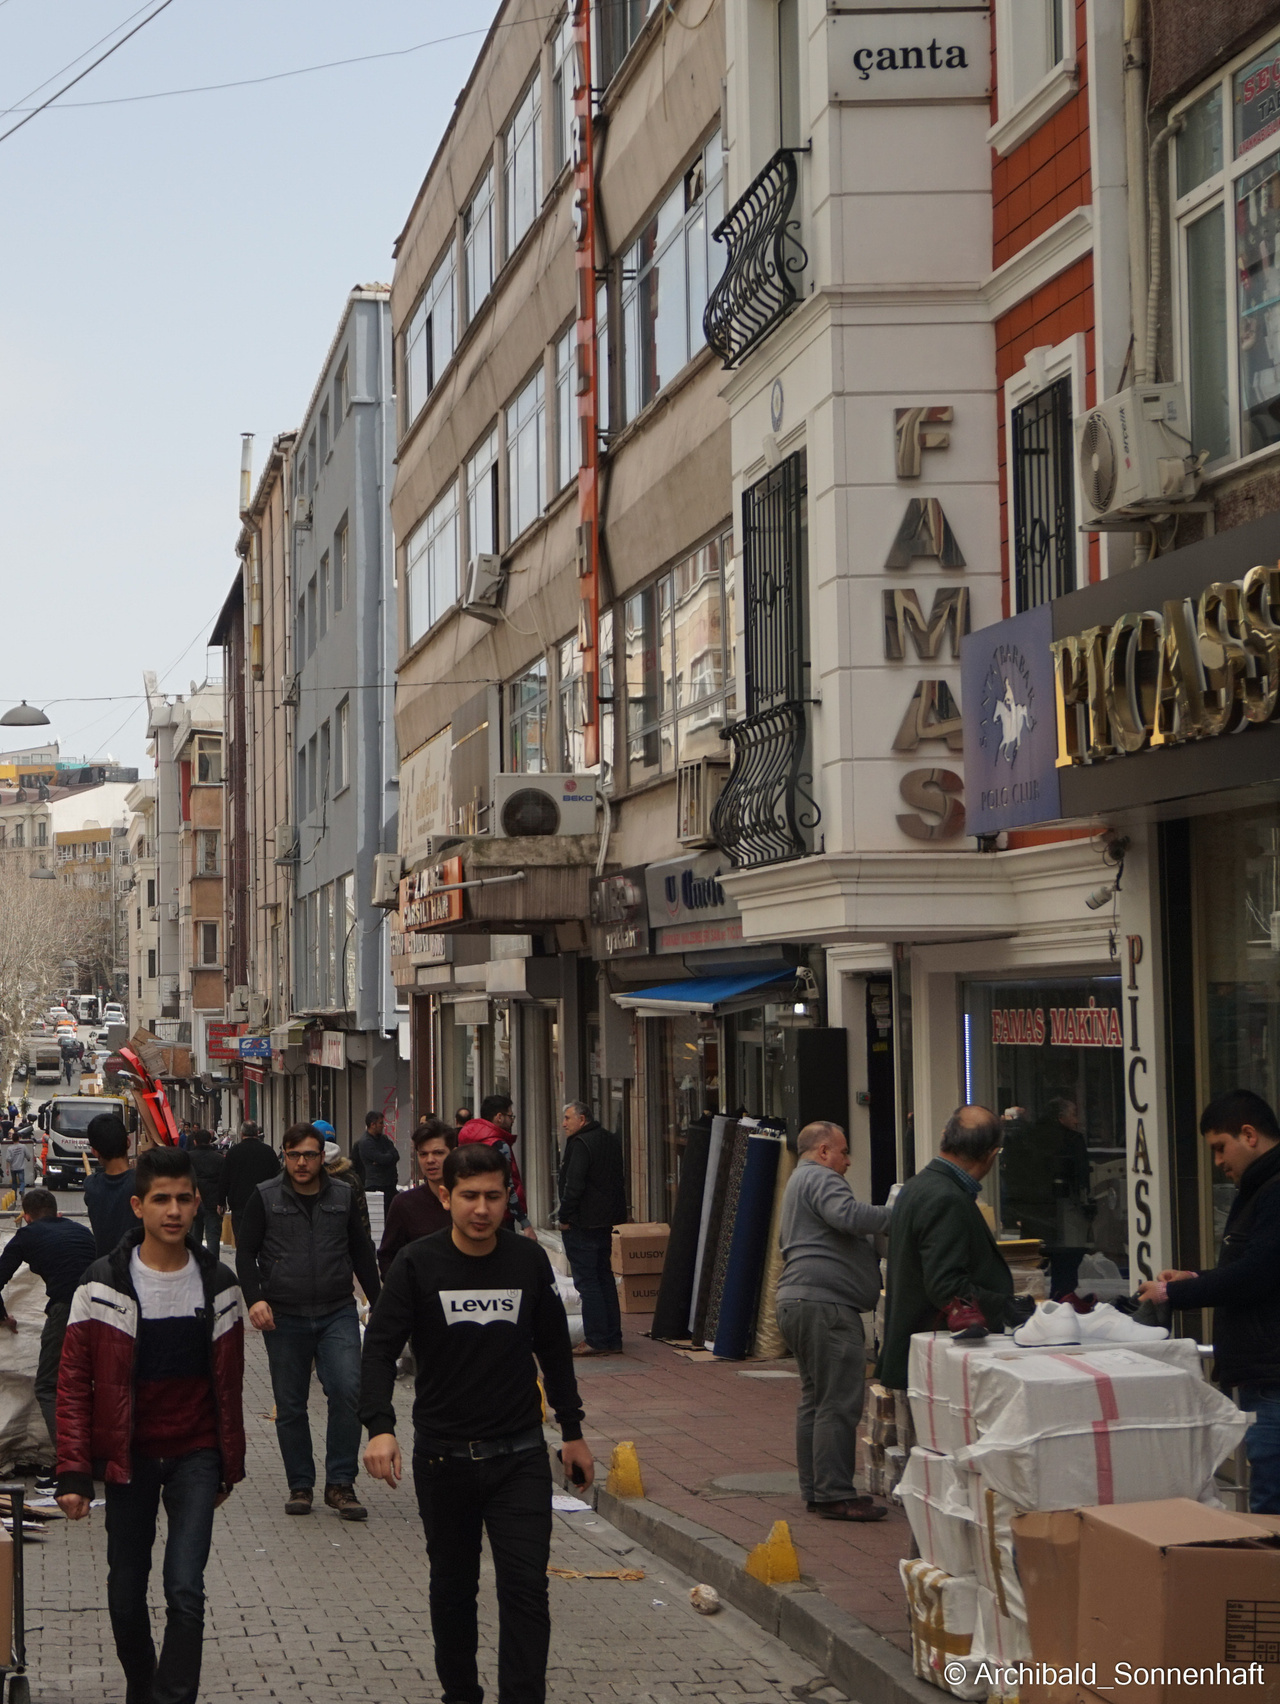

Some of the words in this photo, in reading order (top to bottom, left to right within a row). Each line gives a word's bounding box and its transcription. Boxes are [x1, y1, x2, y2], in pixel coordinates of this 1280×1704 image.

[852, 37, 969, 81] çanta
[882, 406, 972, 841] FAMAS
[562, 794, 595, 803] BEKO
[981, 786, 1009, 811] POLO
[1012, 780, 1041, 804] CLUB
[991, 1007, 1046, 1046] FAMAS
[1049, 995, 1124, 1048] MAKİNA
[240, 1038, 268, 1049] GKS
[628, 1250, 666, 1260] ULUSOY
[450, 1298, 515, 1313] Levi's
